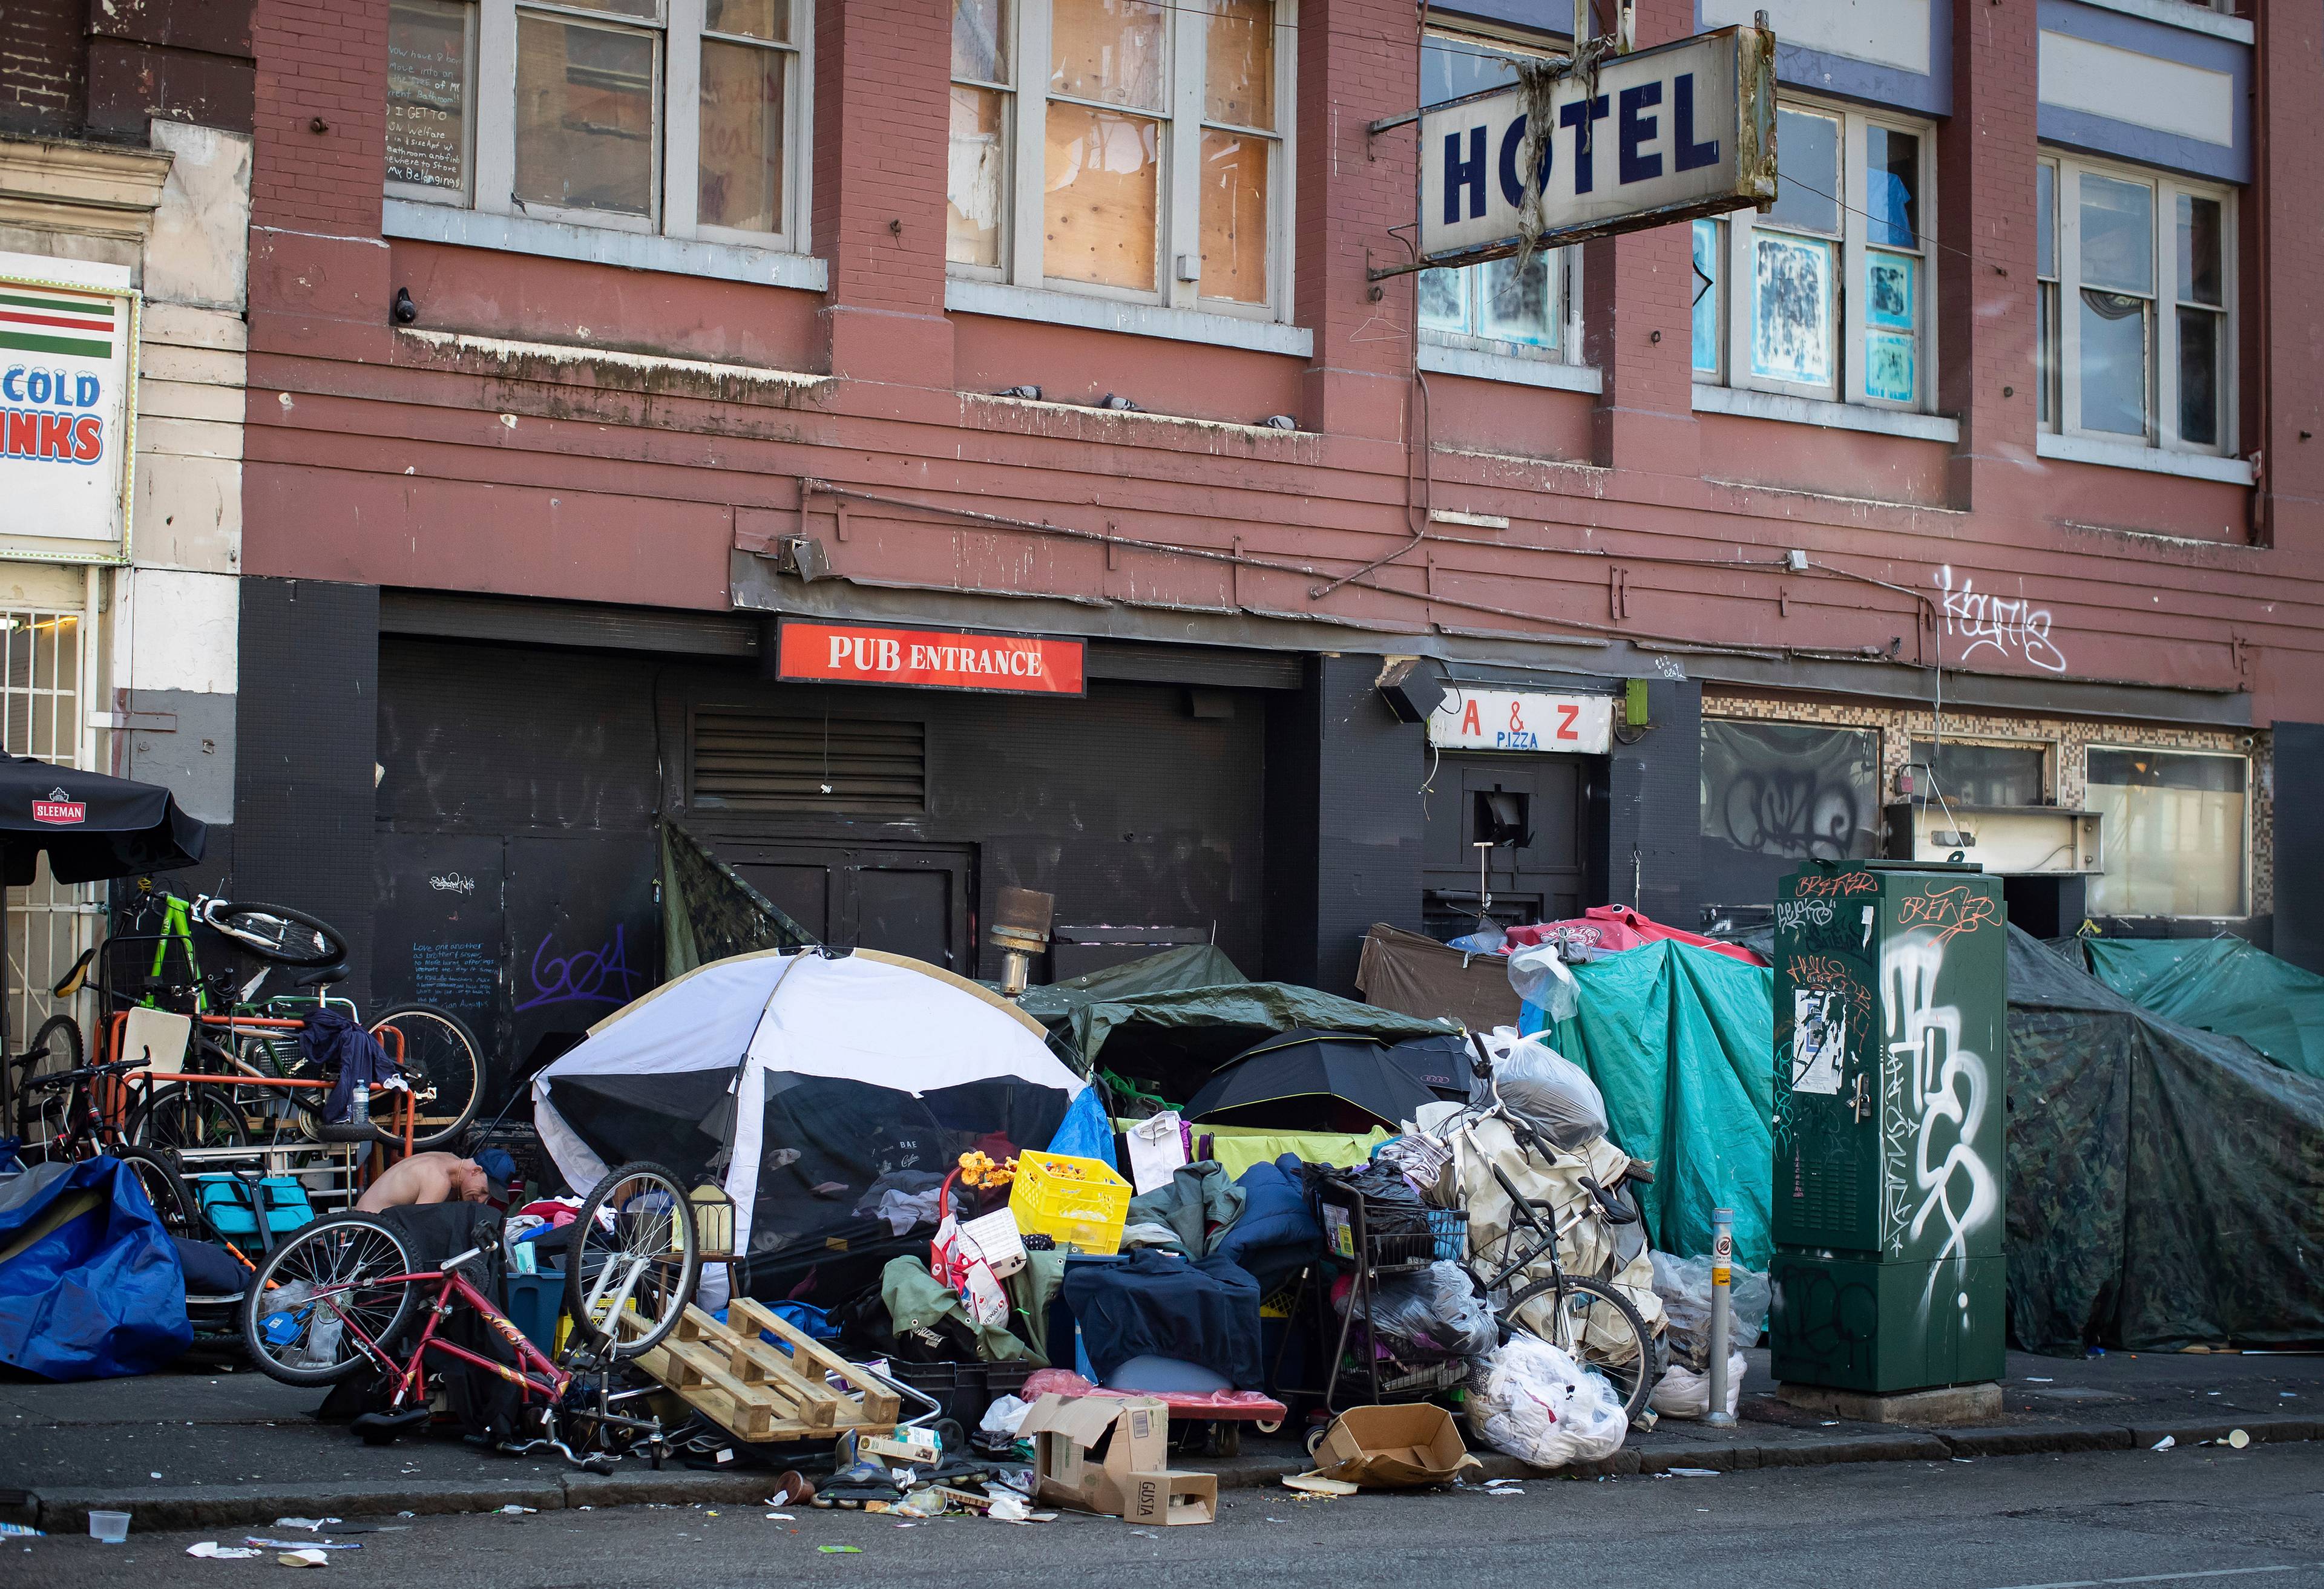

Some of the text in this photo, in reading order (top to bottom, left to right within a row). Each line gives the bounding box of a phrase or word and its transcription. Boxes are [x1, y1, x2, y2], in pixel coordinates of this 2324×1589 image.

[411, 50, 432, 61] have
[389, 62, 453, 79] Move into an
[392, 74, 407, 84] the
[435, 80, 446, 90] of
[417, 90, 460, 103] Bathroom!!
[396, 106, 403, 116] I
[408, 106, 428, 119] GET
[430, 110, 447, 120] TO
[408, 124, 446, 139] Welfare
[1444, 73, 1719, 224] HOTEL
[433, 161, 457, 173] Store
[2, 364, 100, 408] COLD
[828, 635, 1043, 677] PUB ENTRANCE
[1462, 699, 1580, 740] A & Z
[1497, 732, 1538, 749] PIZZA
[37, 805, 82, 817] SLEEMAN
[413, 942, 432, 952] Love
[1140, 1481, 1155, 1516] GUSTA
